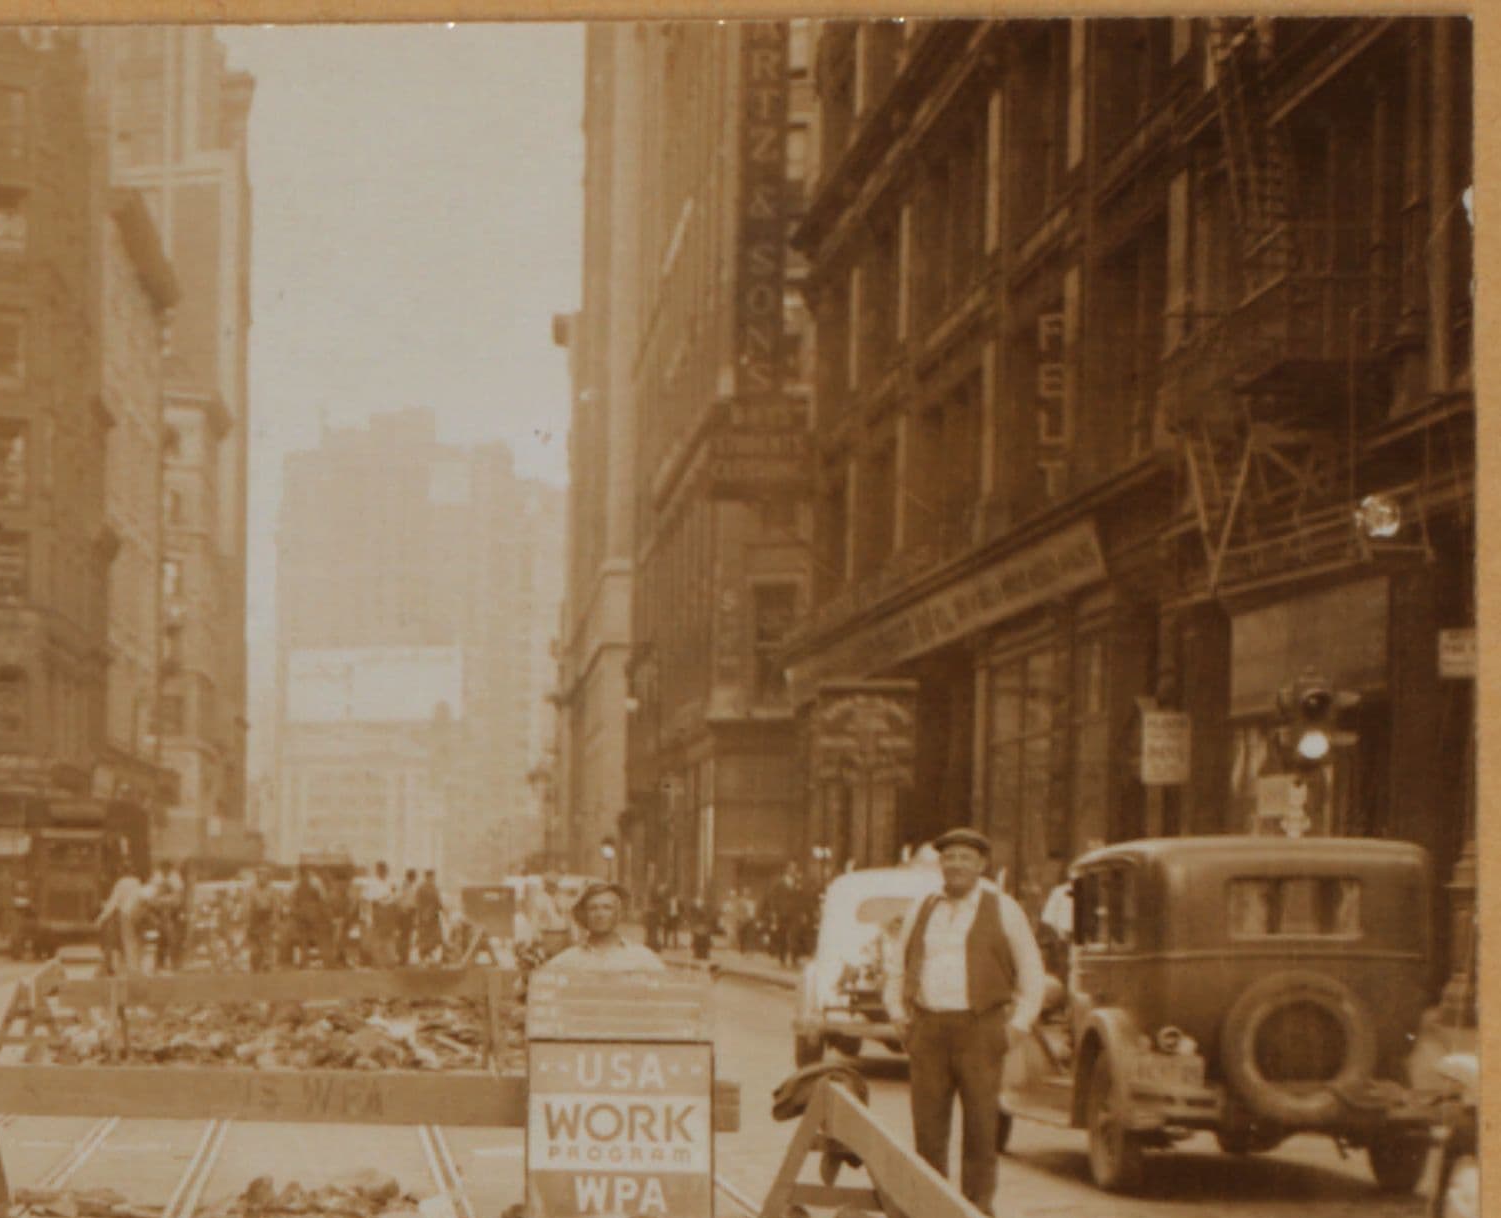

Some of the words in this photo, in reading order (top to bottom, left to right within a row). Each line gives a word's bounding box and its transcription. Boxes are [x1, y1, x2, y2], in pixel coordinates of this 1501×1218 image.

[743, 244, 777, 392] SONS
[576, 1052, 665, 1090] USA
[543, 1102, 695, 1143] WORK
[574, 1175, 668, 1214] WPA
